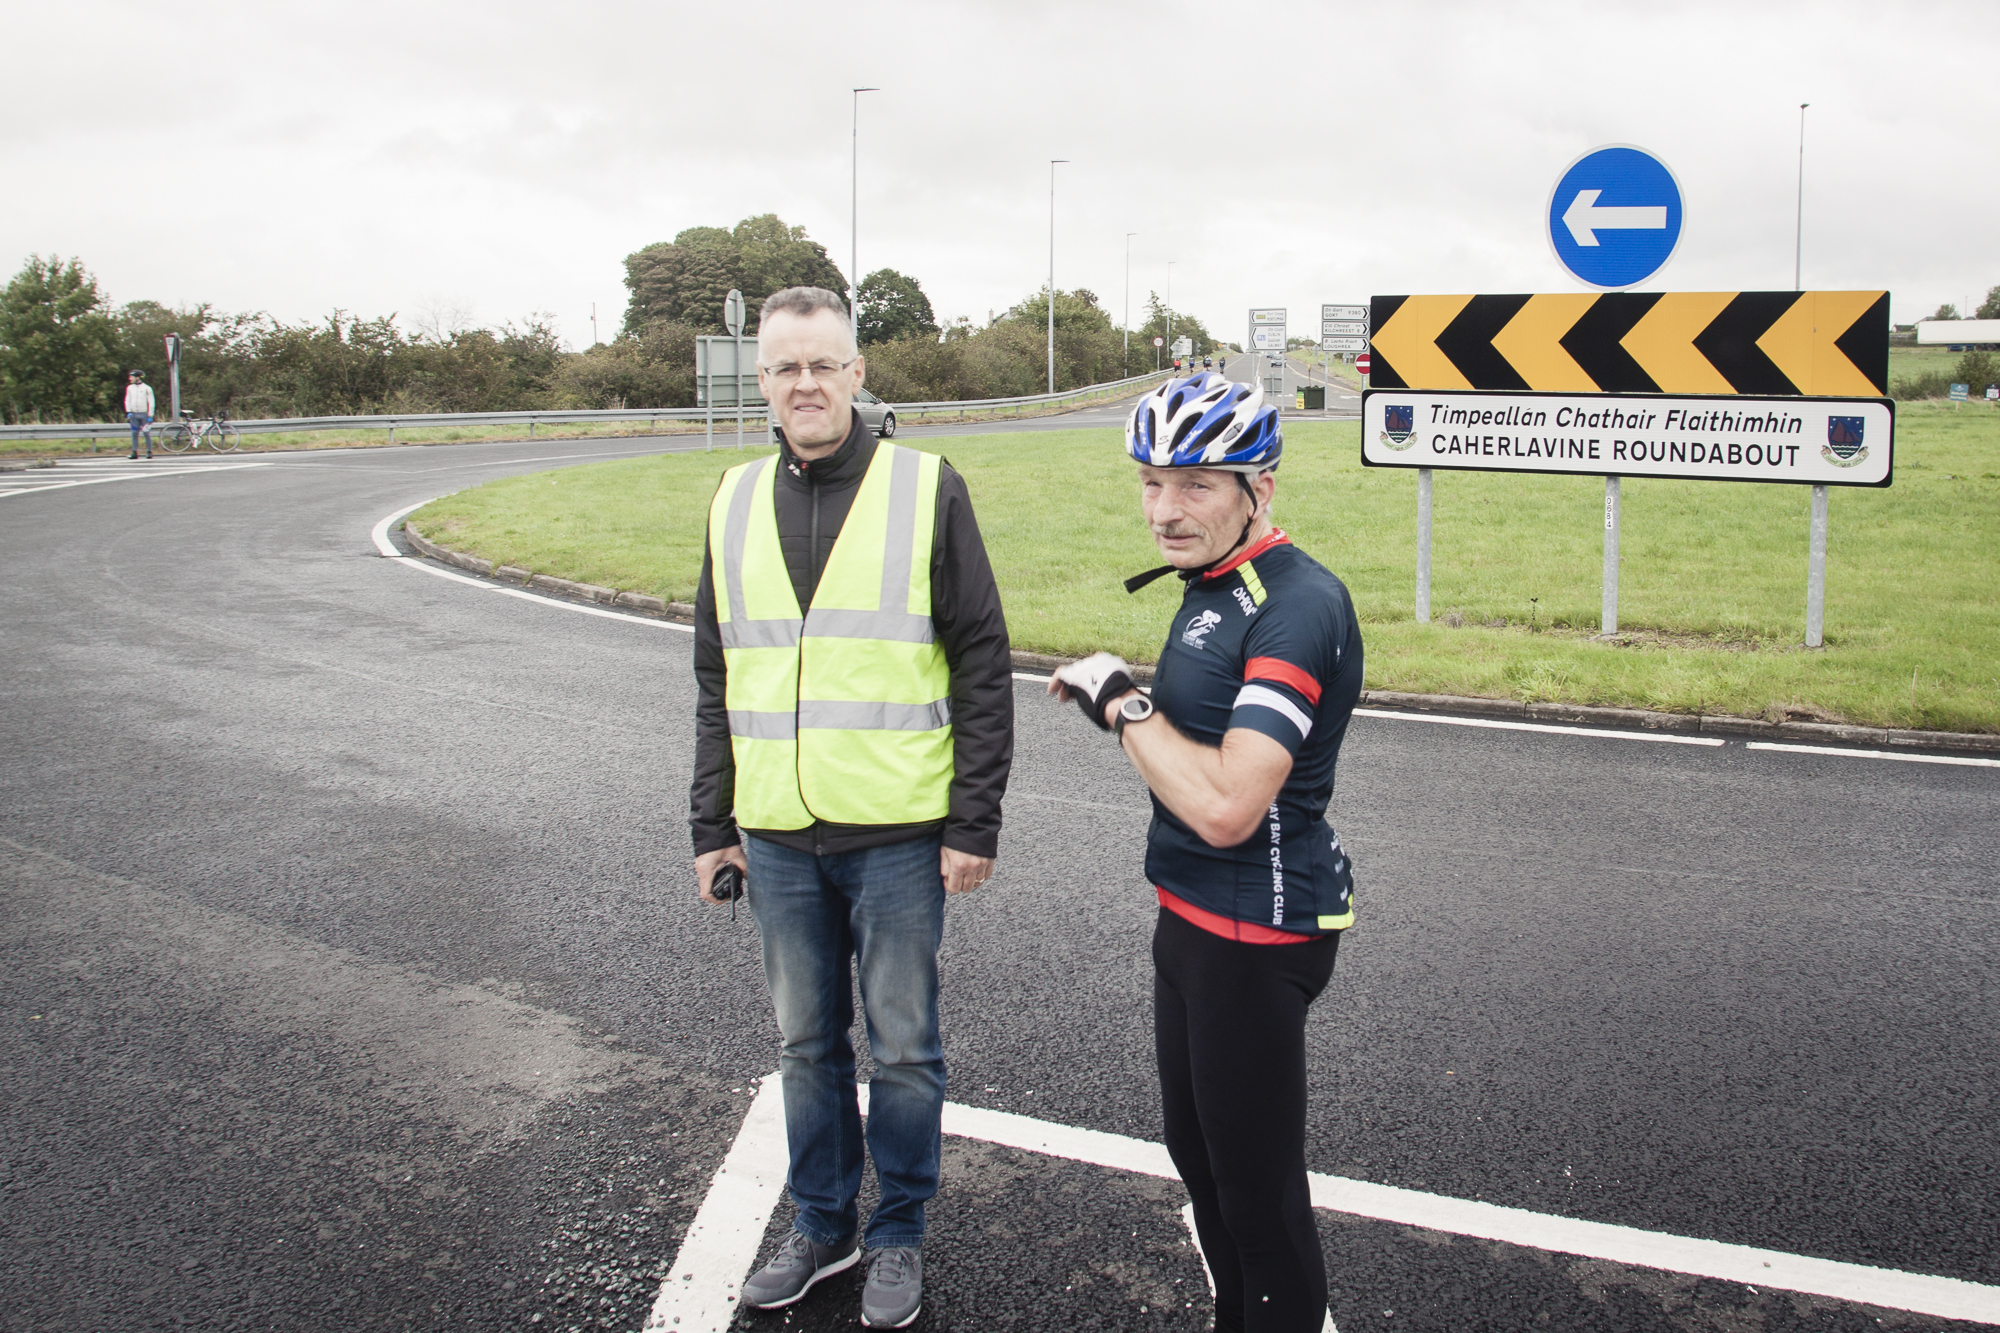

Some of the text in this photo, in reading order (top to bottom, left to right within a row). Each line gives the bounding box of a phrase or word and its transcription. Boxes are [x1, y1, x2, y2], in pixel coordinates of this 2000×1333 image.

[1431, 403, 1802, 435] Timpeallán Chathair Flaithimhin
[1432, 434, 1600, 460] CAHERLAVINE
[1613, 440, 1800, 467] ROUNDABOUT
[1270, 823, 1281, 845] BAY
[1270, 847, 1284, 893] CYCLING
[1272, 894, 1285, 926] CLUB
